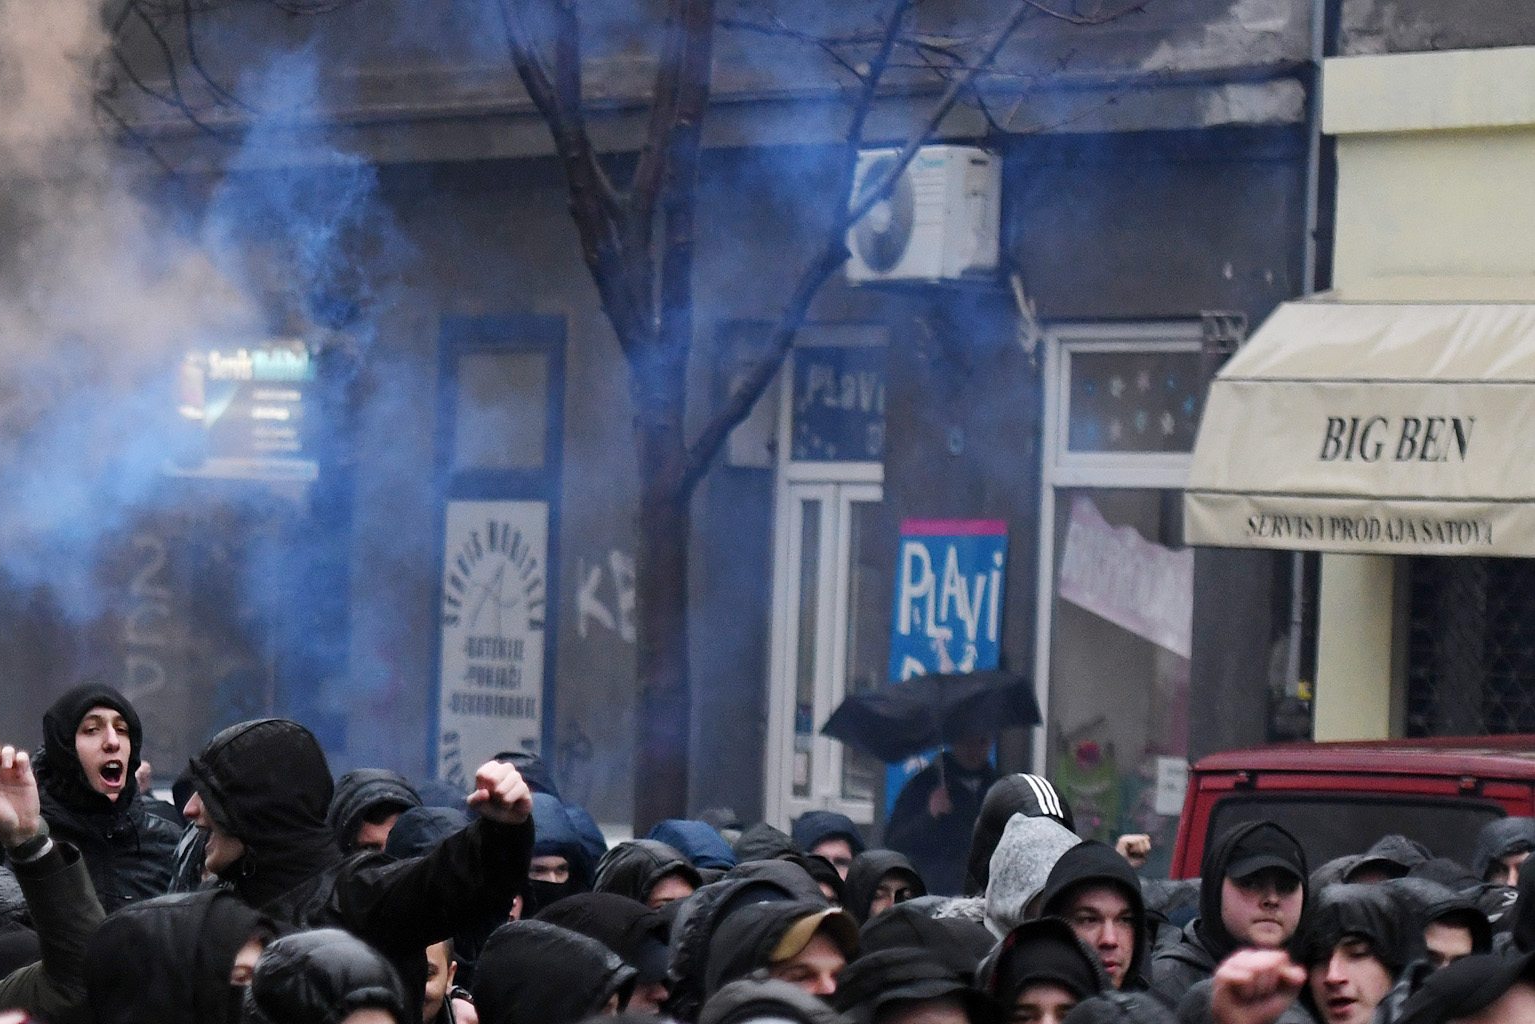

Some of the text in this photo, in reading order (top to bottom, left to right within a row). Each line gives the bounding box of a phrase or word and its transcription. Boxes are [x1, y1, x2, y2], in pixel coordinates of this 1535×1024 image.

[1319, 415, 1477, 464] BIG BEN
[1247, 514, 1314, 541] SERVIS
[1330, 516, 1417, 545] PRODAJA
[1422, 518, 1493, 546] SATOVA
